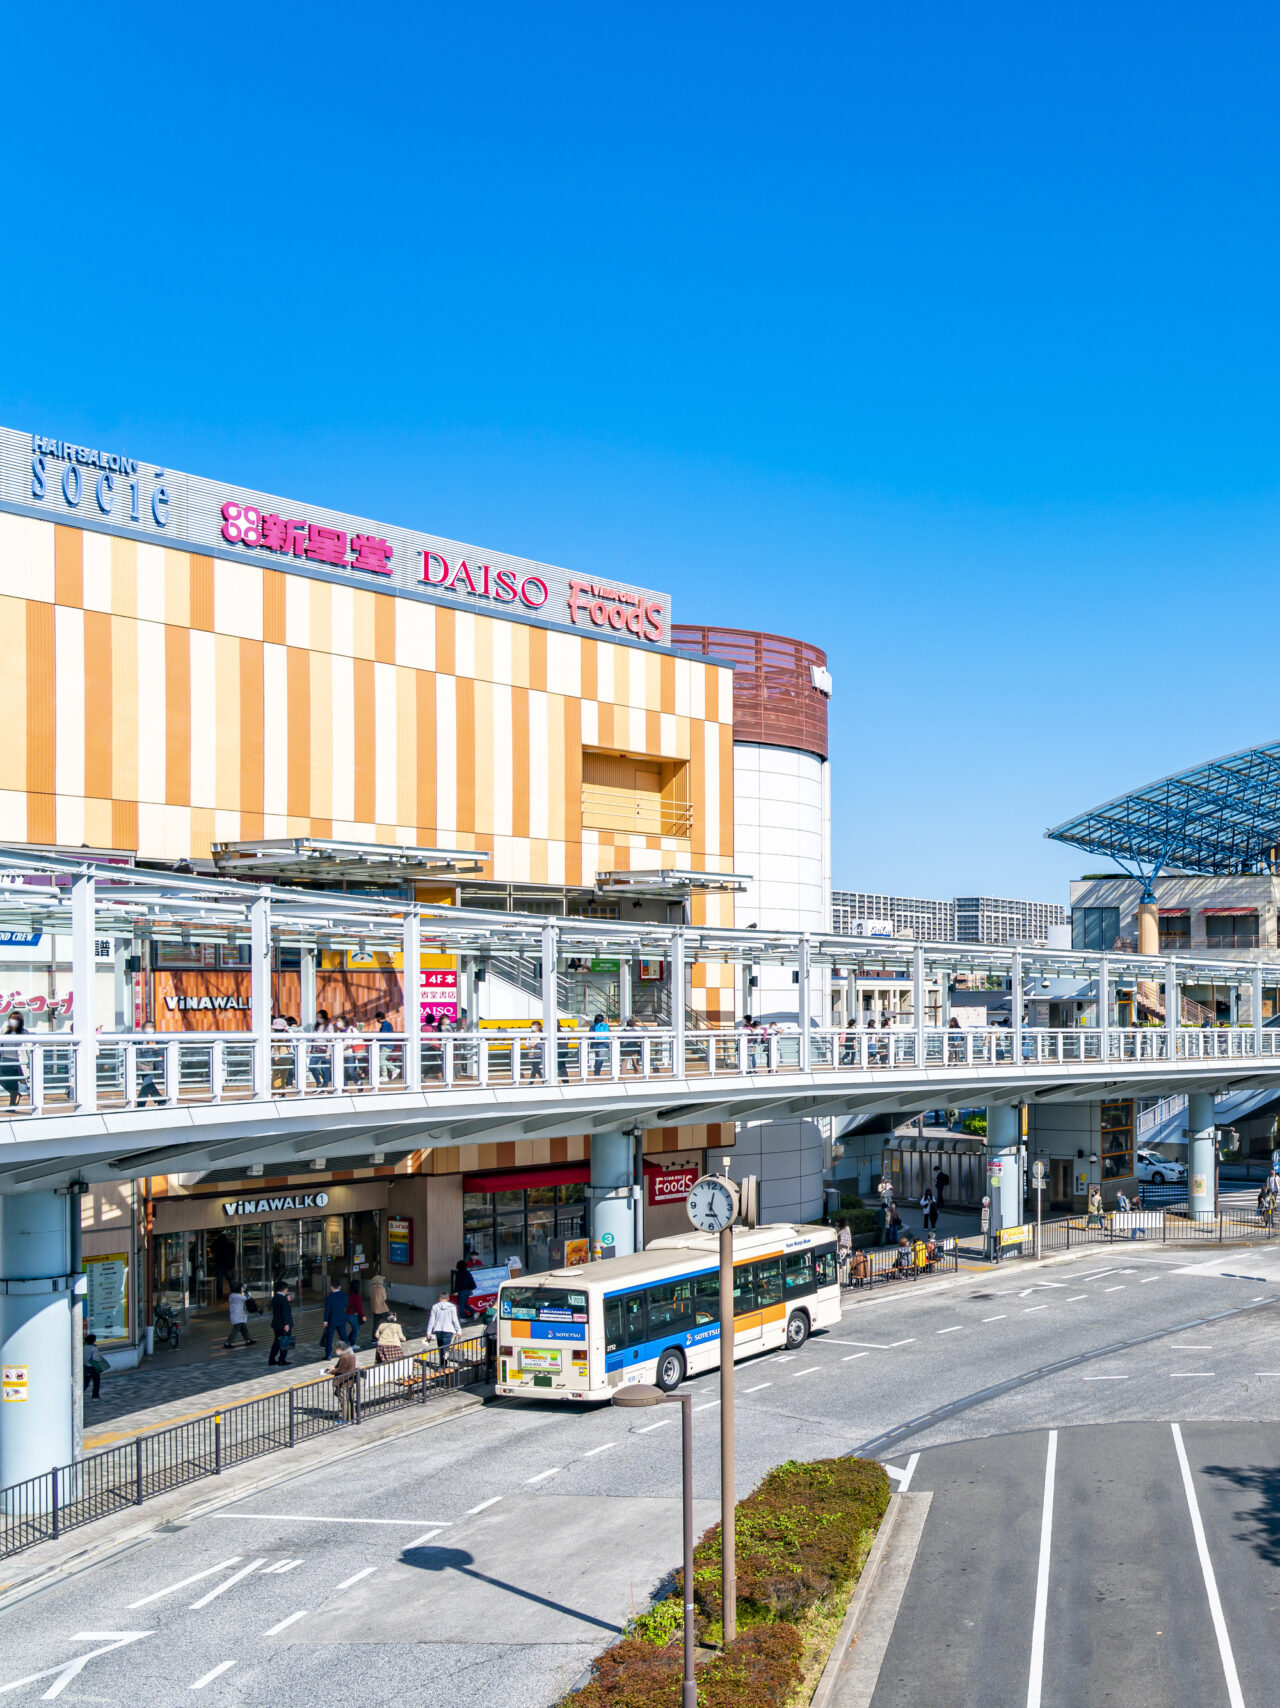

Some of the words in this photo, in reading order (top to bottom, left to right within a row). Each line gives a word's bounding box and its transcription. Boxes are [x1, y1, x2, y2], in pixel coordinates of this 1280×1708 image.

[261, 513, 393, 576] 新星堂
[420, 549, 550, 608] DAISO
[568, 580, 664, 641] Foods
[12, 932, 35, 942] CREW
[428, 975, 443, 984] 4F
[165, 995, 253, 1010] ViNAWAL
[690, 1201, 696, 1209] 9
[727, 1203, 732, 1211] 3
[708, 1223, 714, 1231] 6
[605, 1235, 612, 1243] 3
